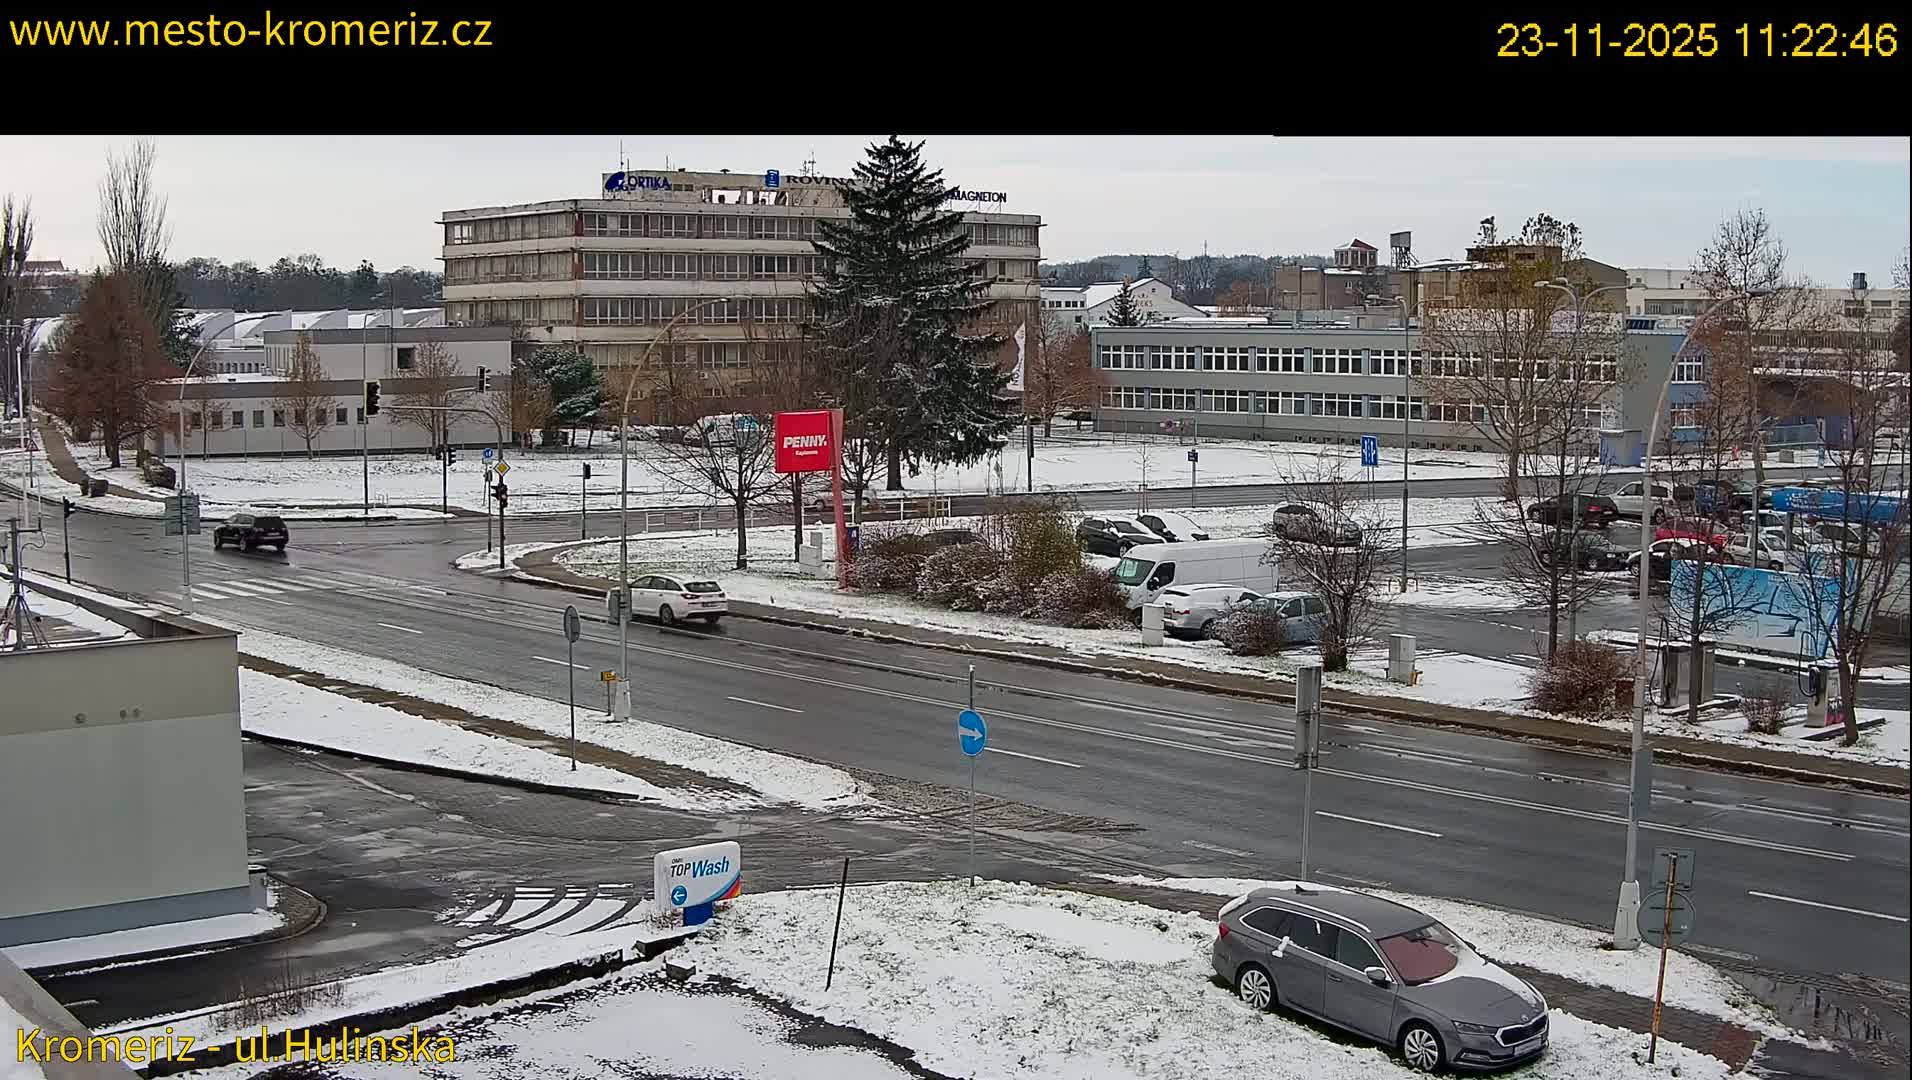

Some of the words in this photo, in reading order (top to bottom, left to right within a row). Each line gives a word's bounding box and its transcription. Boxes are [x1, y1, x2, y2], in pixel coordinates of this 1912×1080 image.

[628, 175, 672, 190] ORTIKA
[952, 190, 1007, 203] MAGNETON
[671, 862, 691, 877] TOP
[692, 856, 730, 879] Wash
